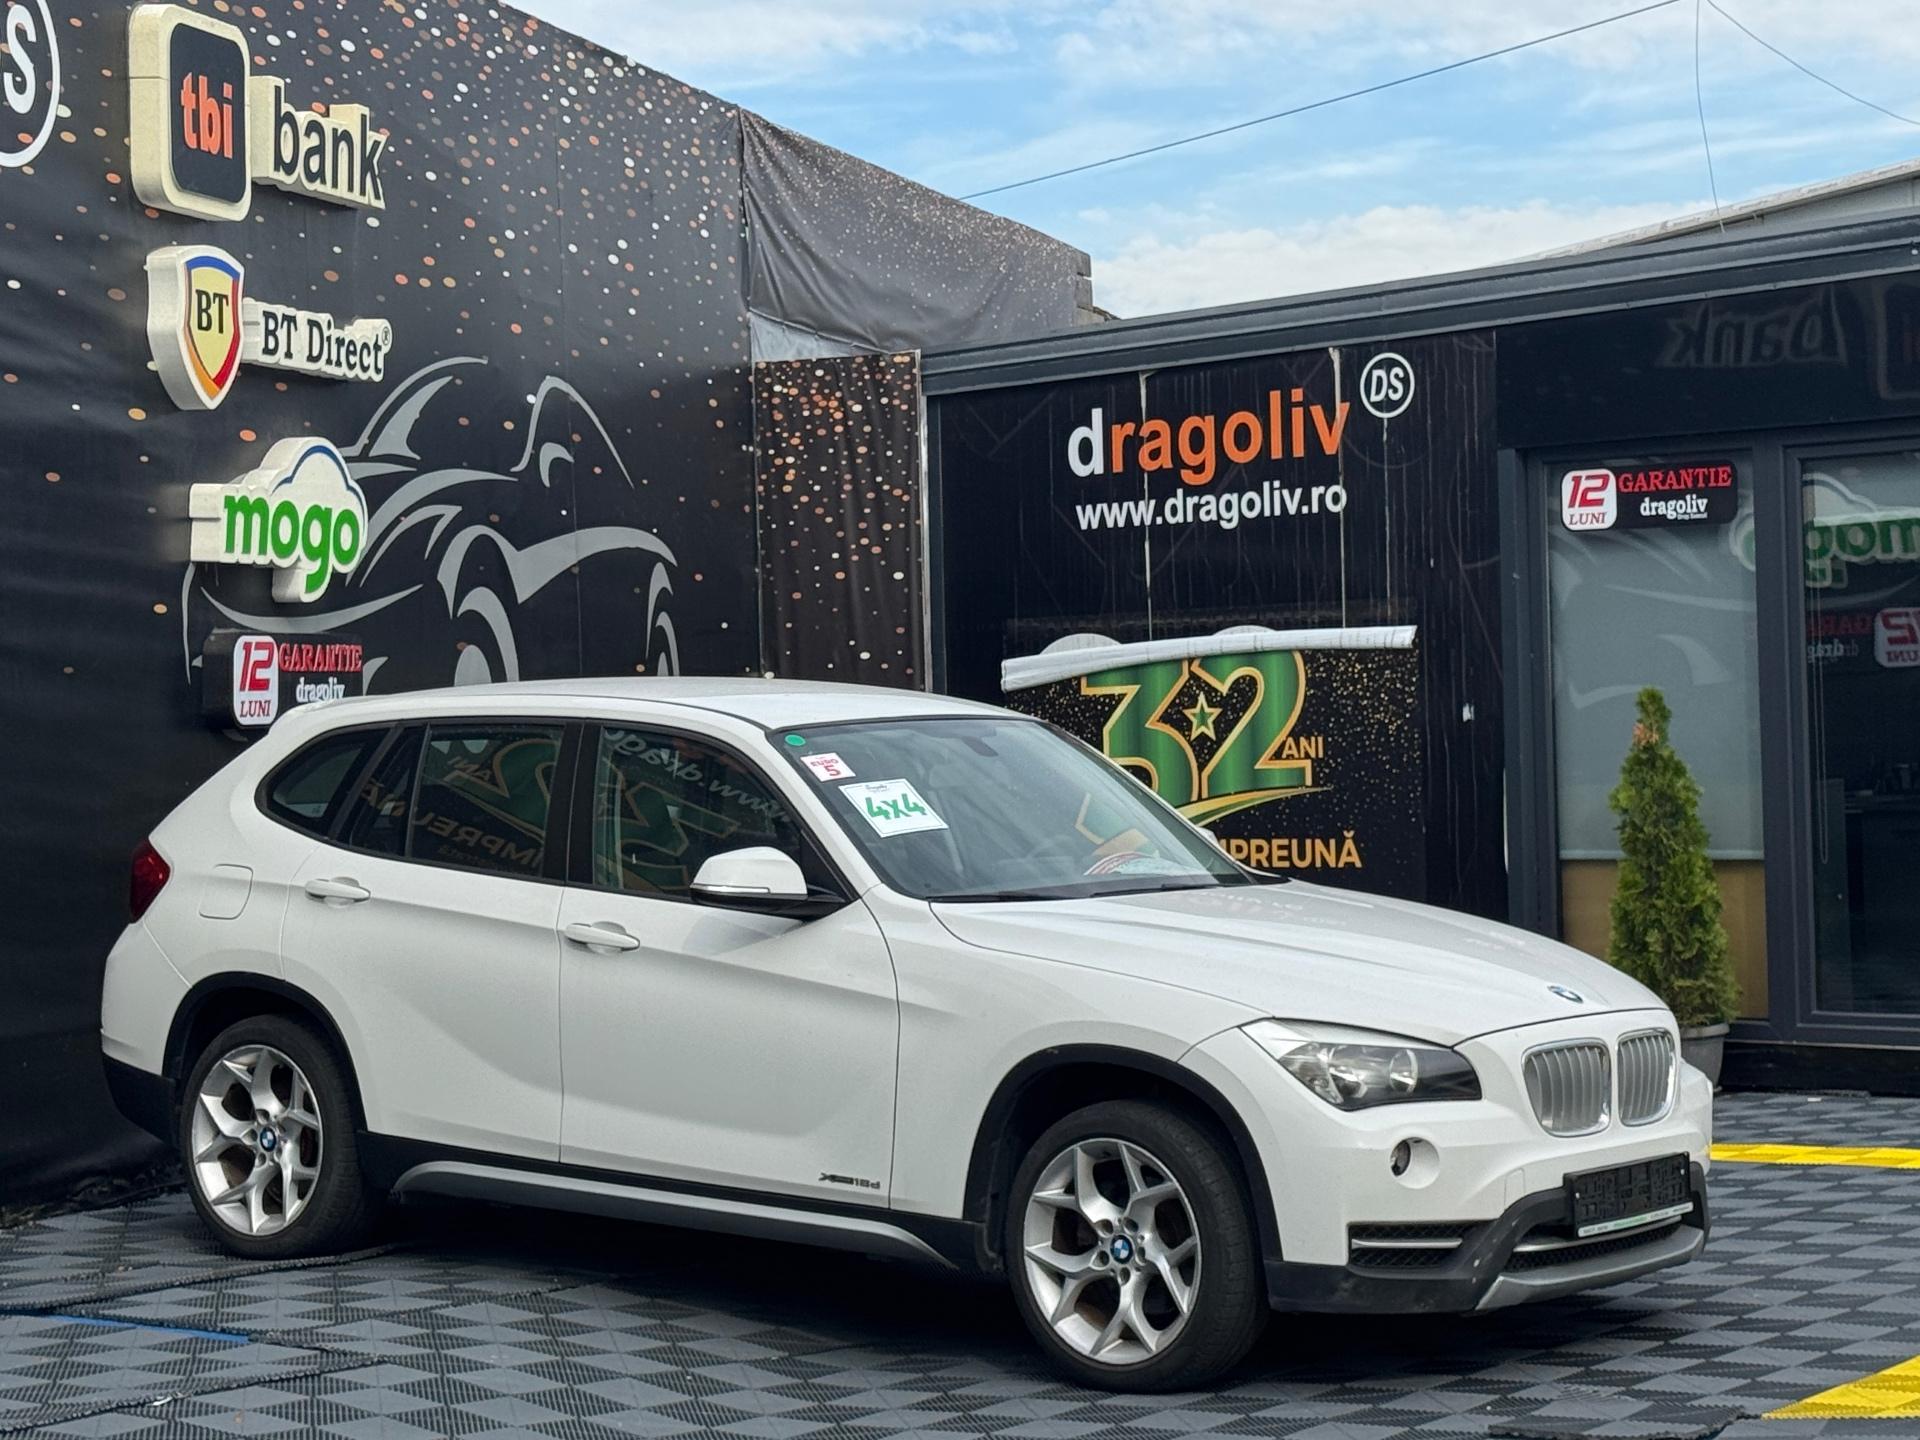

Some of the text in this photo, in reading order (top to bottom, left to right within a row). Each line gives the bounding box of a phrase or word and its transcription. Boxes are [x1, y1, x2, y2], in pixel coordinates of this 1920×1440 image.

[181, 72, 384, 200] tbi bank
[195, 289, 229, 334] BT
[262, 311, 298, 359] BT
[1370, 367, 1404, 402] DS
[1067, 388, 1351, 485] dragoliv
[1568, 473, 1610, 509] 12
[1618, 466, 1733, 492] GARANTIE
[1075, 480, 1348, 529] www.dragoliv.ro
[1568, 512, 1608, 526] LUNI
[1640, 494, 1708, 520] dragoliv
[224, 495, 360, 594] mogo
[239, 641, 276, 691] 12
[278, 643, 363, 672] GARANTIE
[296, 677, 345, 702] dragoliv
[240, 700, 272, 718] LUNI
[1081, 649, 1313, 801] 32
[1282, 736, 1324, 759] ANI
[824, 764, 841, 777] 5
